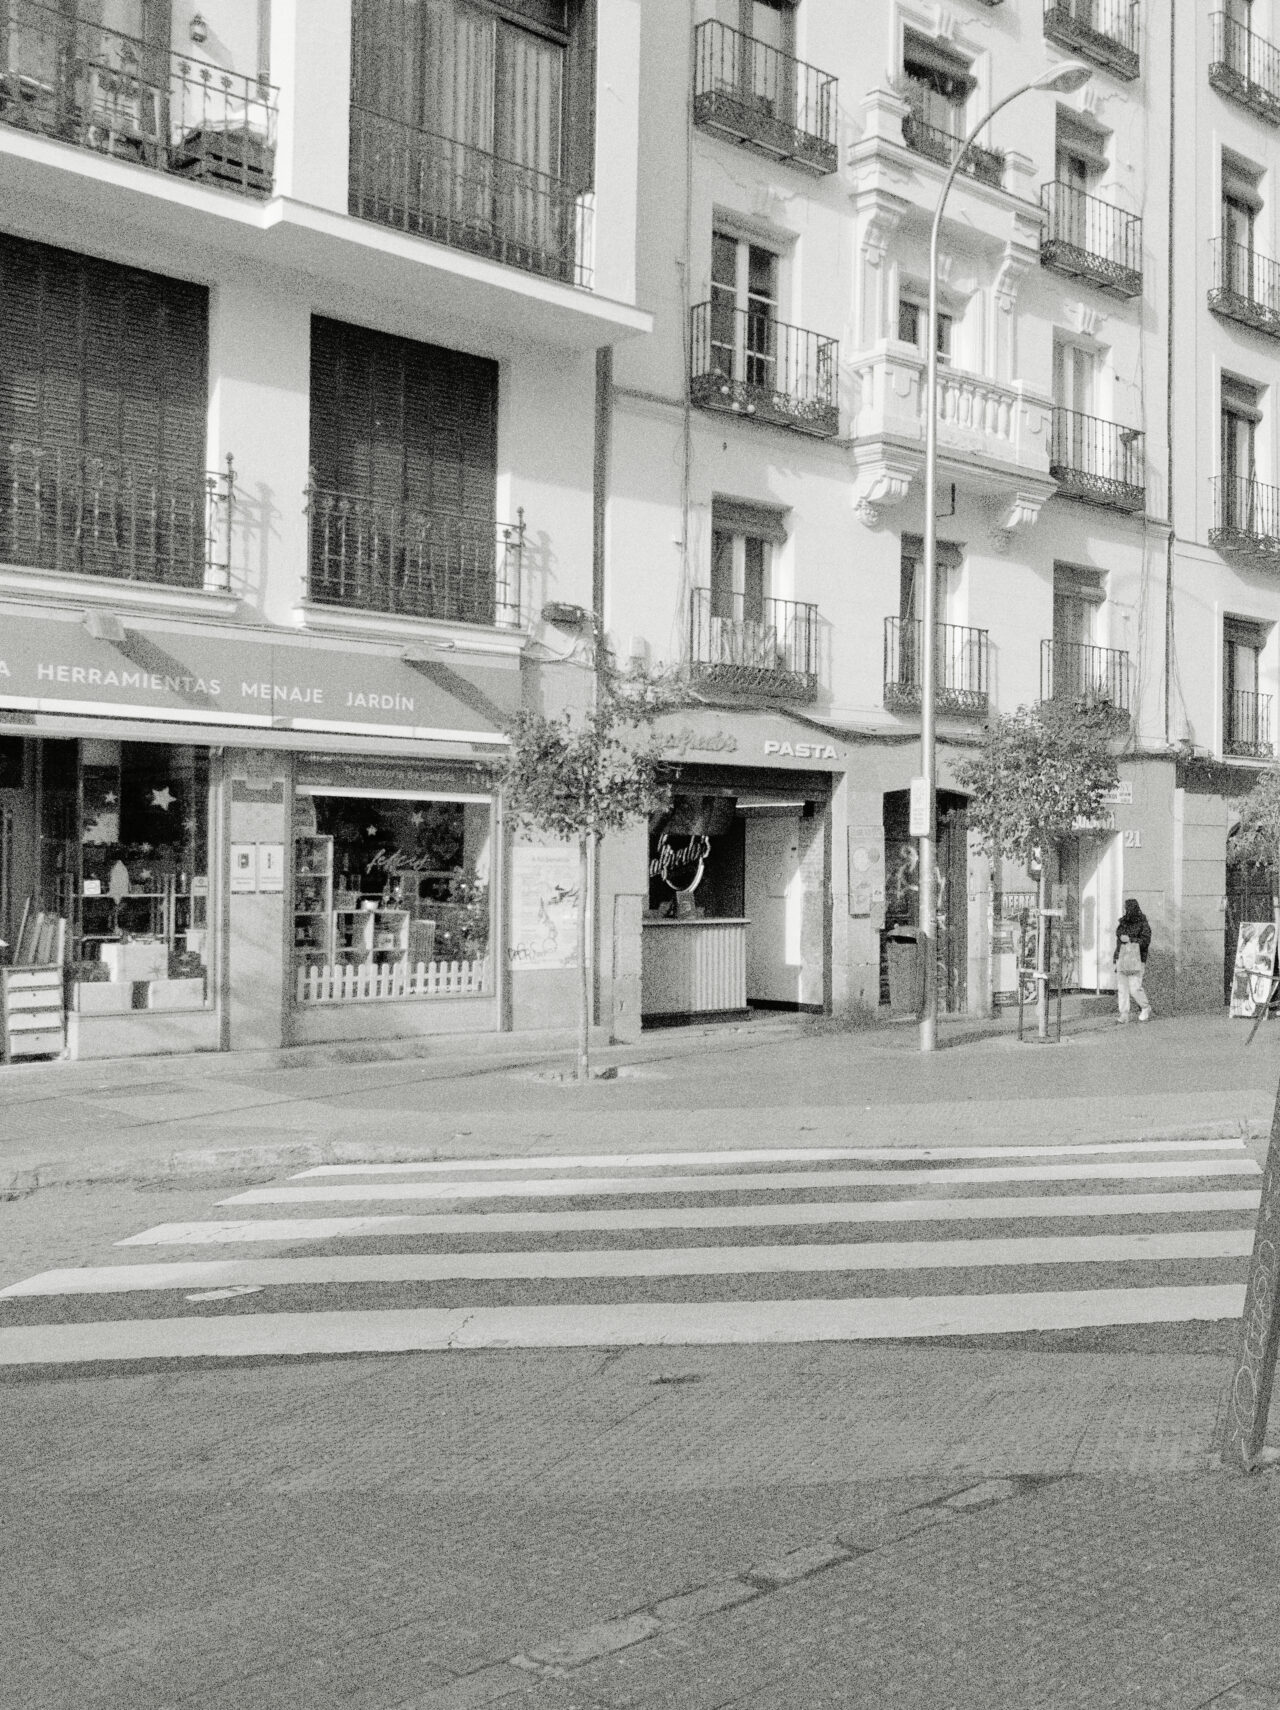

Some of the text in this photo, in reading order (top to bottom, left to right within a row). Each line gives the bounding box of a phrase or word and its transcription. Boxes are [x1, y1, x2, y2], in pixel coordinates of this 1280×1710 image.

[37, 663, 221, 695] HERRAMIENTAS
[241, 682, 324, 704] MENAJE
[345, 690, 415, 712] JARDÍN
[764, 740, 840, 760] PASTA
[1125, 830, 1142, 848] 21
